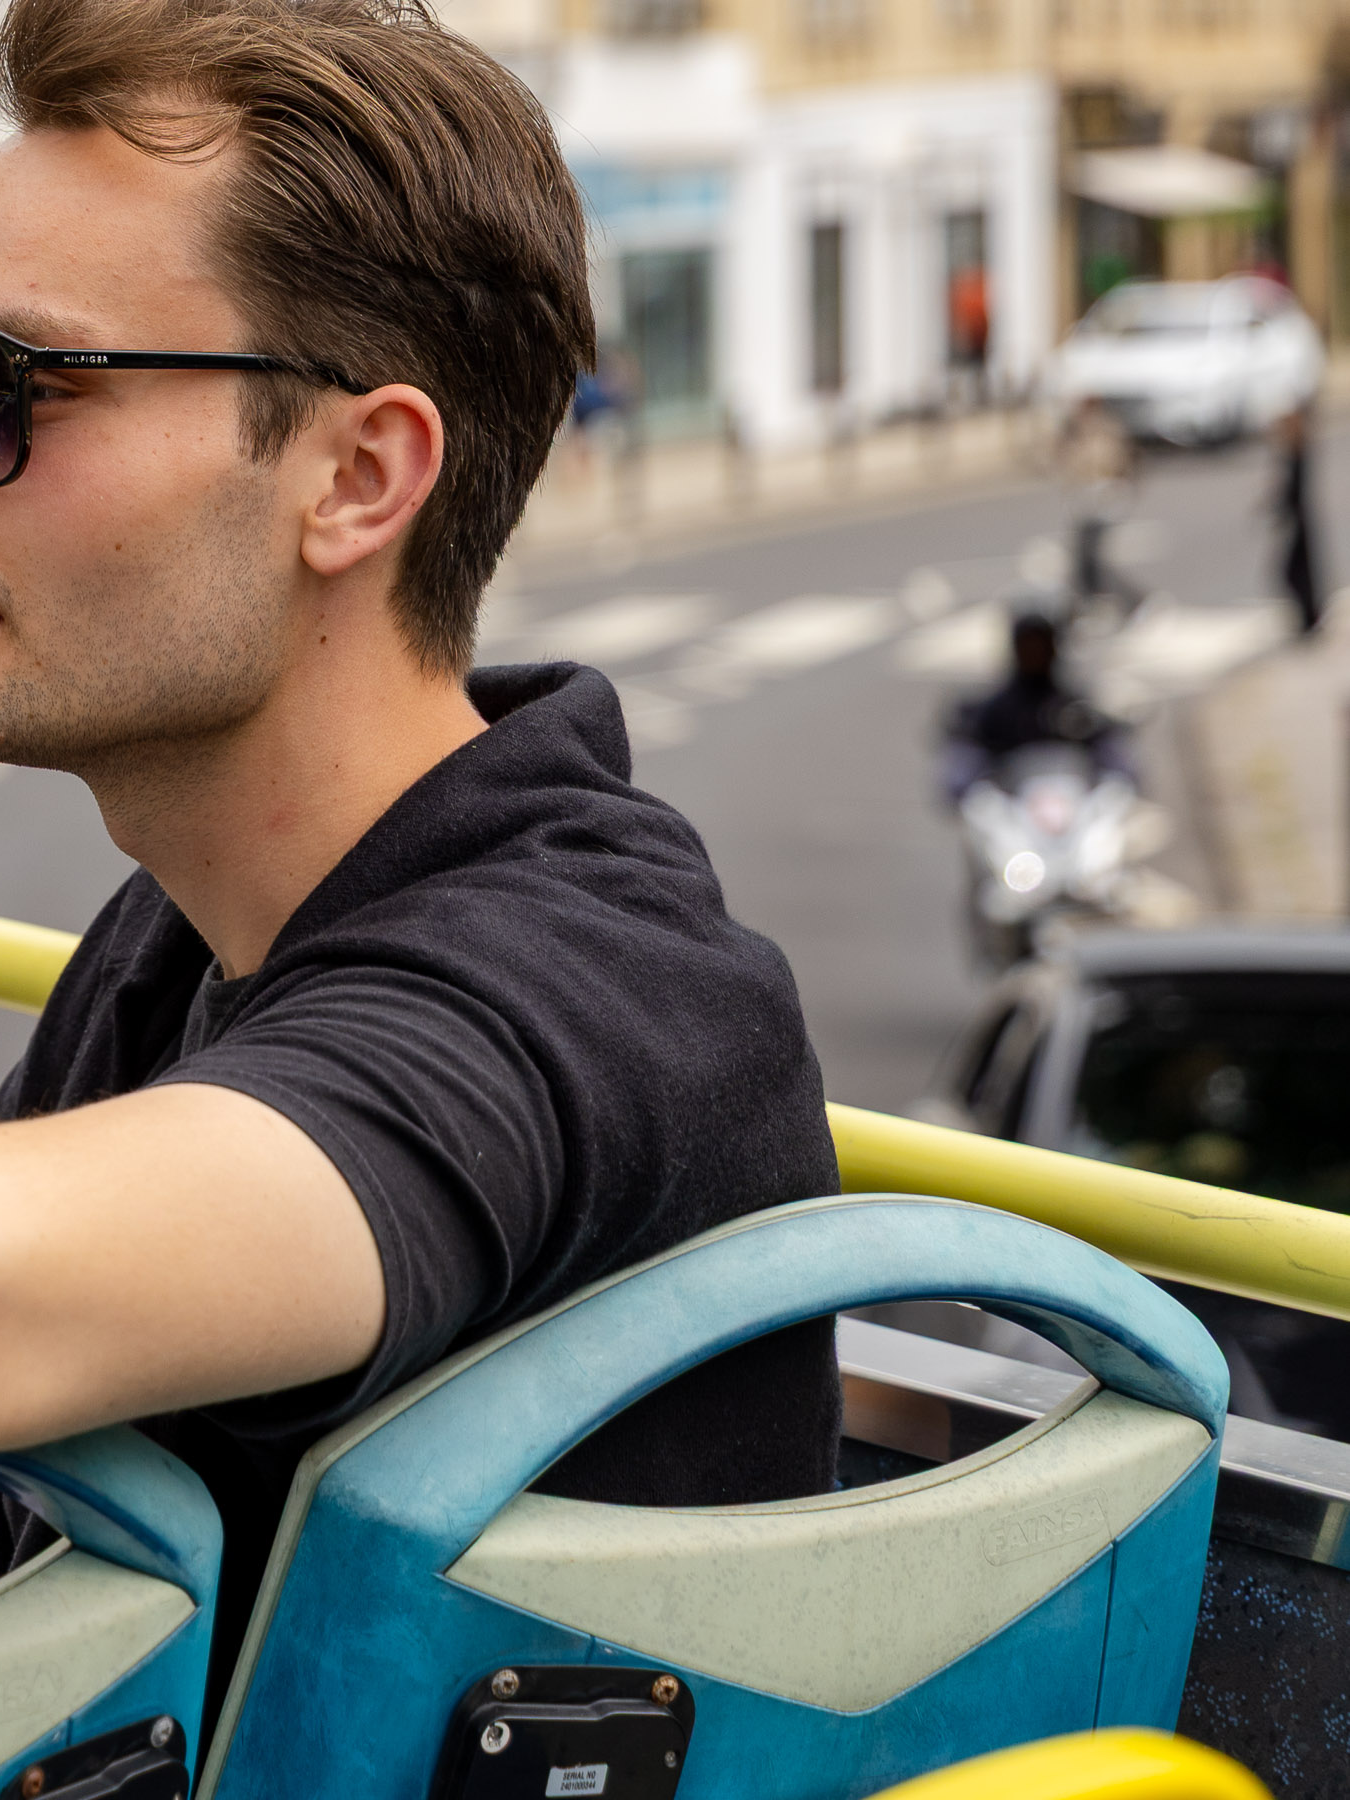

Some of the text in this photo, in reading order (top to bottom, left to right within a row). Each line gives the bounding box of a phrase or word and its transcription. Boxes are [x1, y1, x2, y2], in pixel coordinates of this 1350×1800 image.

[64, 355, 109, 364] HILFIGER
[987, 1497, 1107, 1556] FAINSA
[562, 1770, 596, 1780] SERIAL NO
